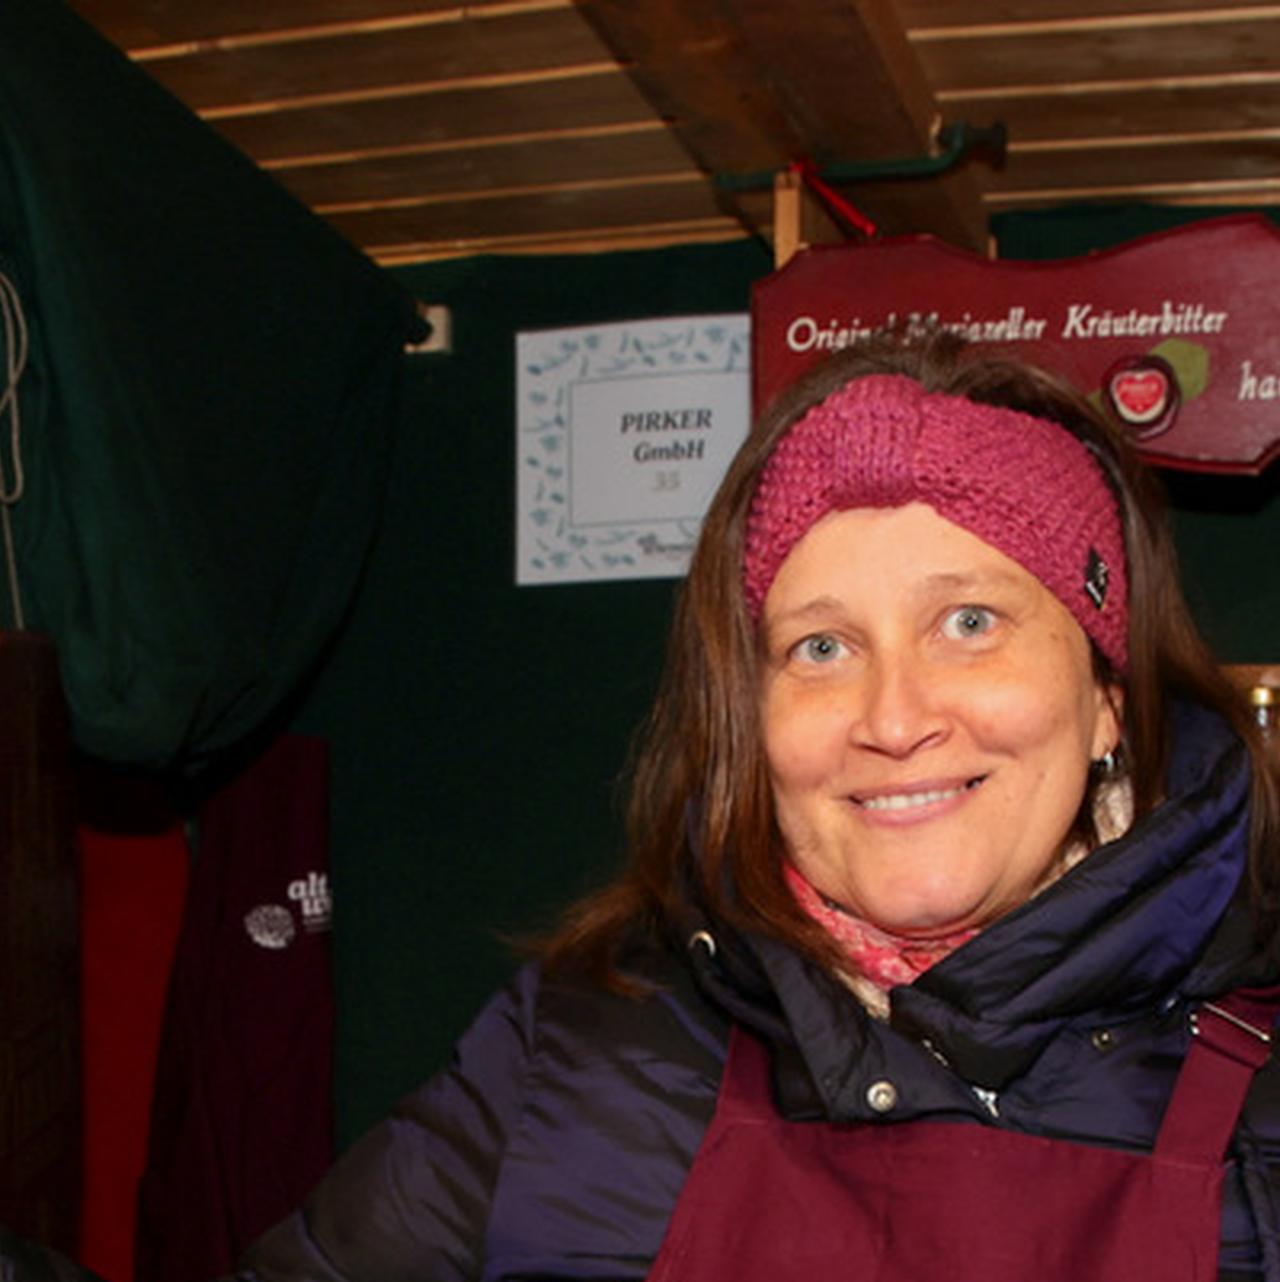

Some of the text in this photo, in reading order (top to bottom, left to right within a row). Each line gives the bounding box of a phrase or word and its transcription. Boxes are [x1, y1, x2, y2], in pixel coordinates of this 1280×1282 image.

[1062, 302, 1228, 339] Kräuterbitter
[620, 408, 714, 434] PIRKER
[633, 440, 705, 463] GmbH
